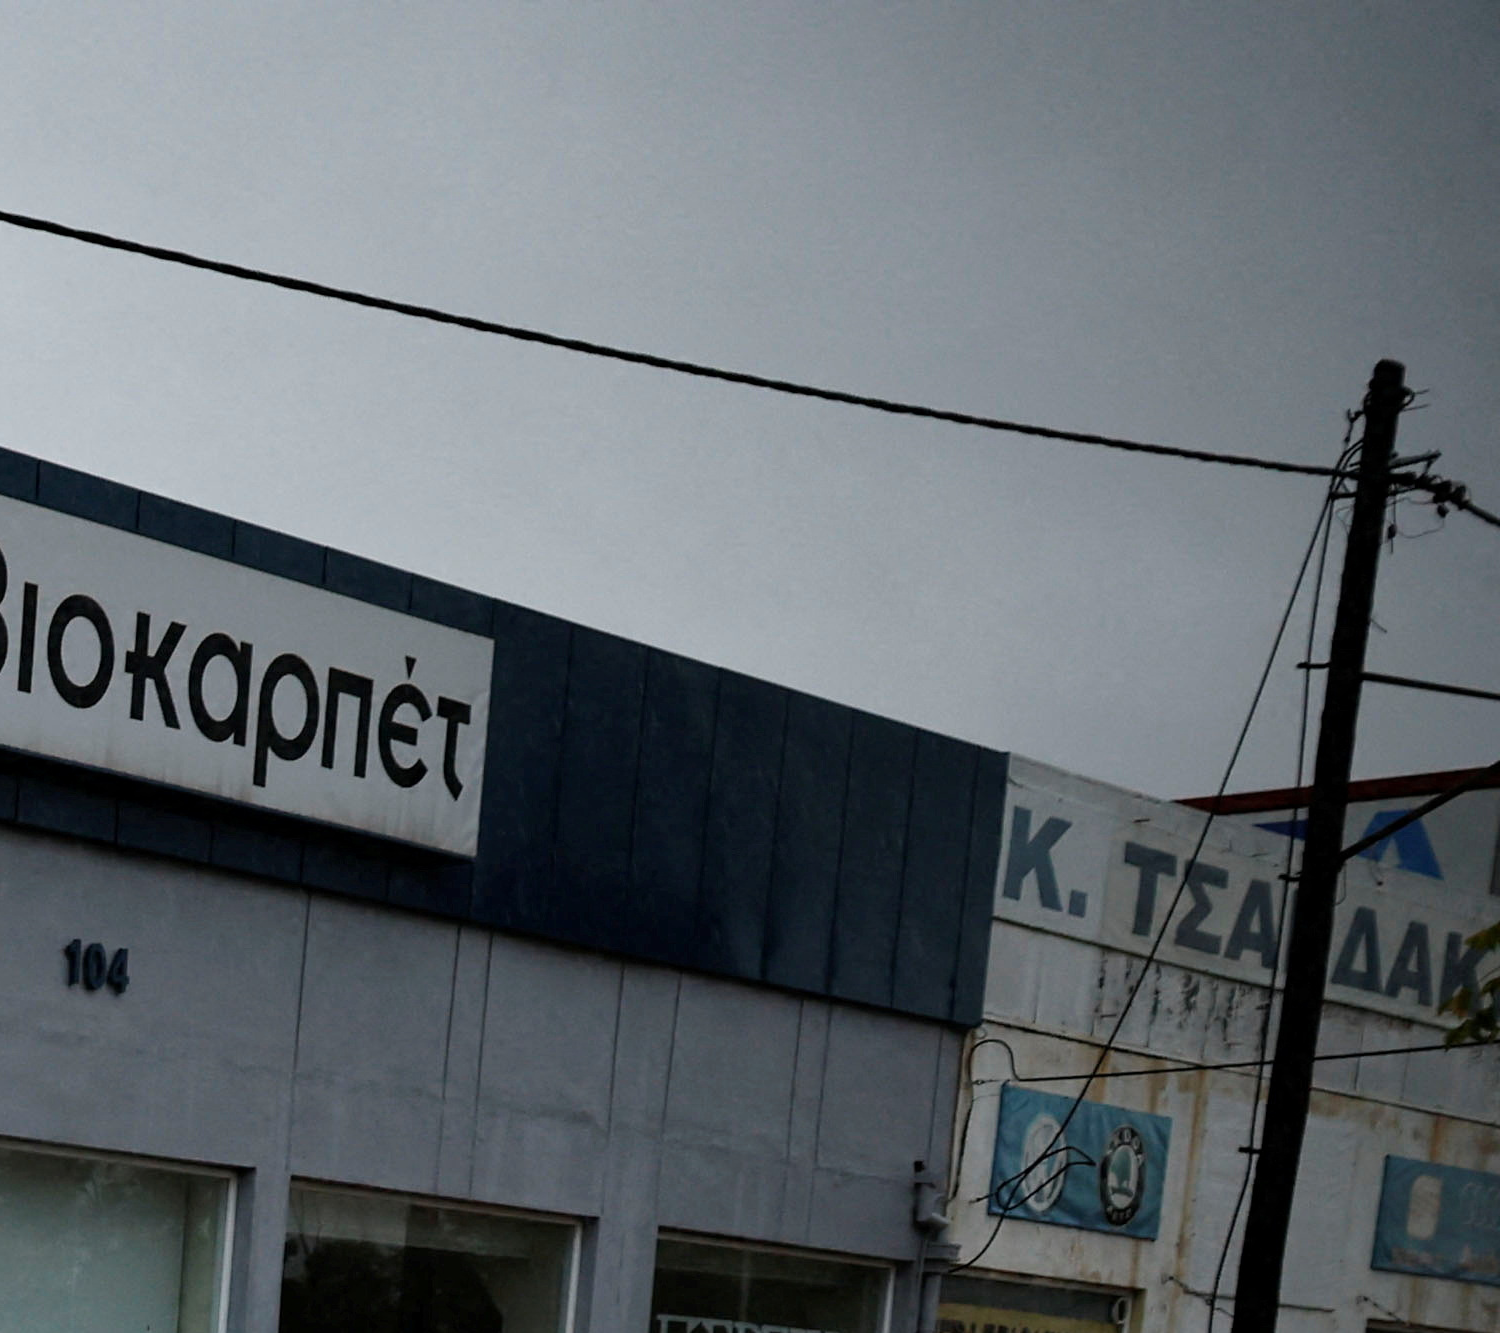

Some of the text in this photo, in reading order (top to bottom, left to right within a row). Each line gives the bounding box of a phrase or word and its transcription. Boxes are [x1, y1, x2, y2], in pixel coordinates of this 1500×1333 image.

[63, 938, 131, 996] 104
[1001, 804, 1500, 1018] Κ. ΤΣΑΔΑΚ
